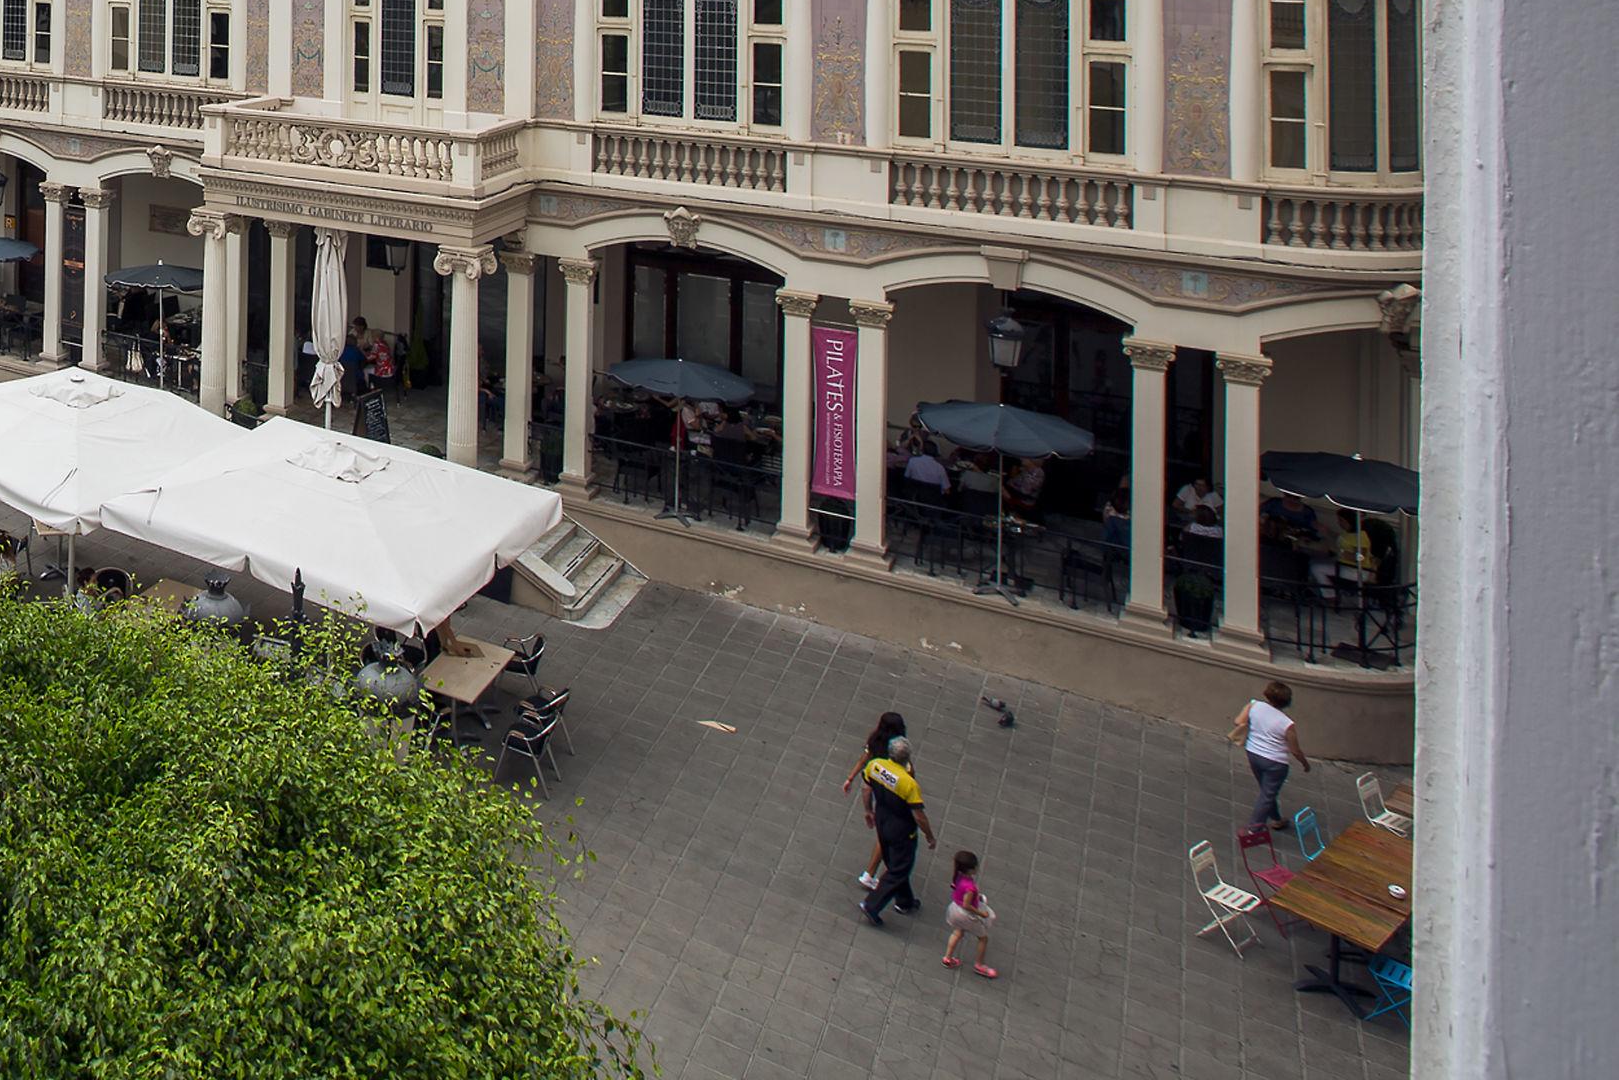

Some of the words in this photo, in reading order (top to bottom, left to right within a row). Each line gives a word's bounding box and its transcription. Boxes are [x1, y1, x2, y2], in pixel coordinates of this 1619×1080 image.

[235, 195, 303, 215] ILUSTRISIMO
[308, 206, 365, 224] GABINETE
[370, 214, 433, 233] LITERARIO
[826, 338, 844, 413] PILATES
[833, 413, 842, 421] &
[833, 422, 843, 486] FISIOTERAPIA
